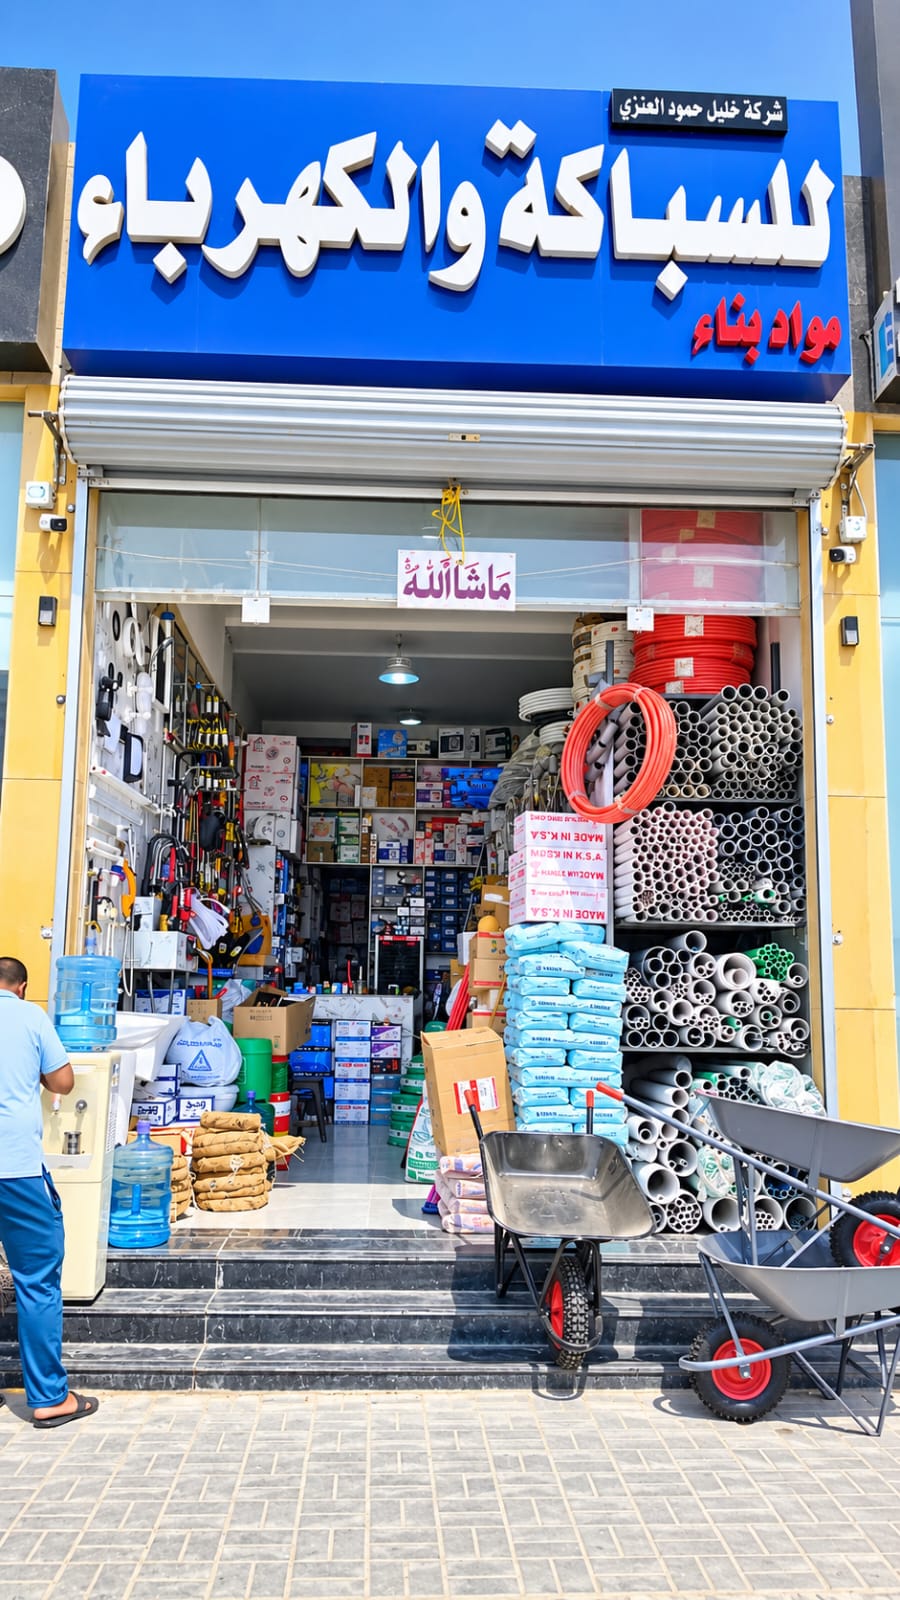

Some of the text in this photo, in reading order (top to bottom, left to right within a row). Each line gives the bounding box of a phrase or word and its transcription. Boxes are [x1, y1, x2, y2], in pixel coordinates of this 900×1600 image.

[619, 95, 784, 126] شركة خليل حمود العنزي
[76, 130, 487, 293] والكهرباء
[484, 118, 836, 301] للسباكة
[691, 291, 763, 365] بناء
[768, 299, 843, 364] مواد
[560, 832, 571, 841] IN
[573, 832, 604, 843] MADE
[562, 908, 573, 919] IN
[575, 908, 606, 920] MADE
